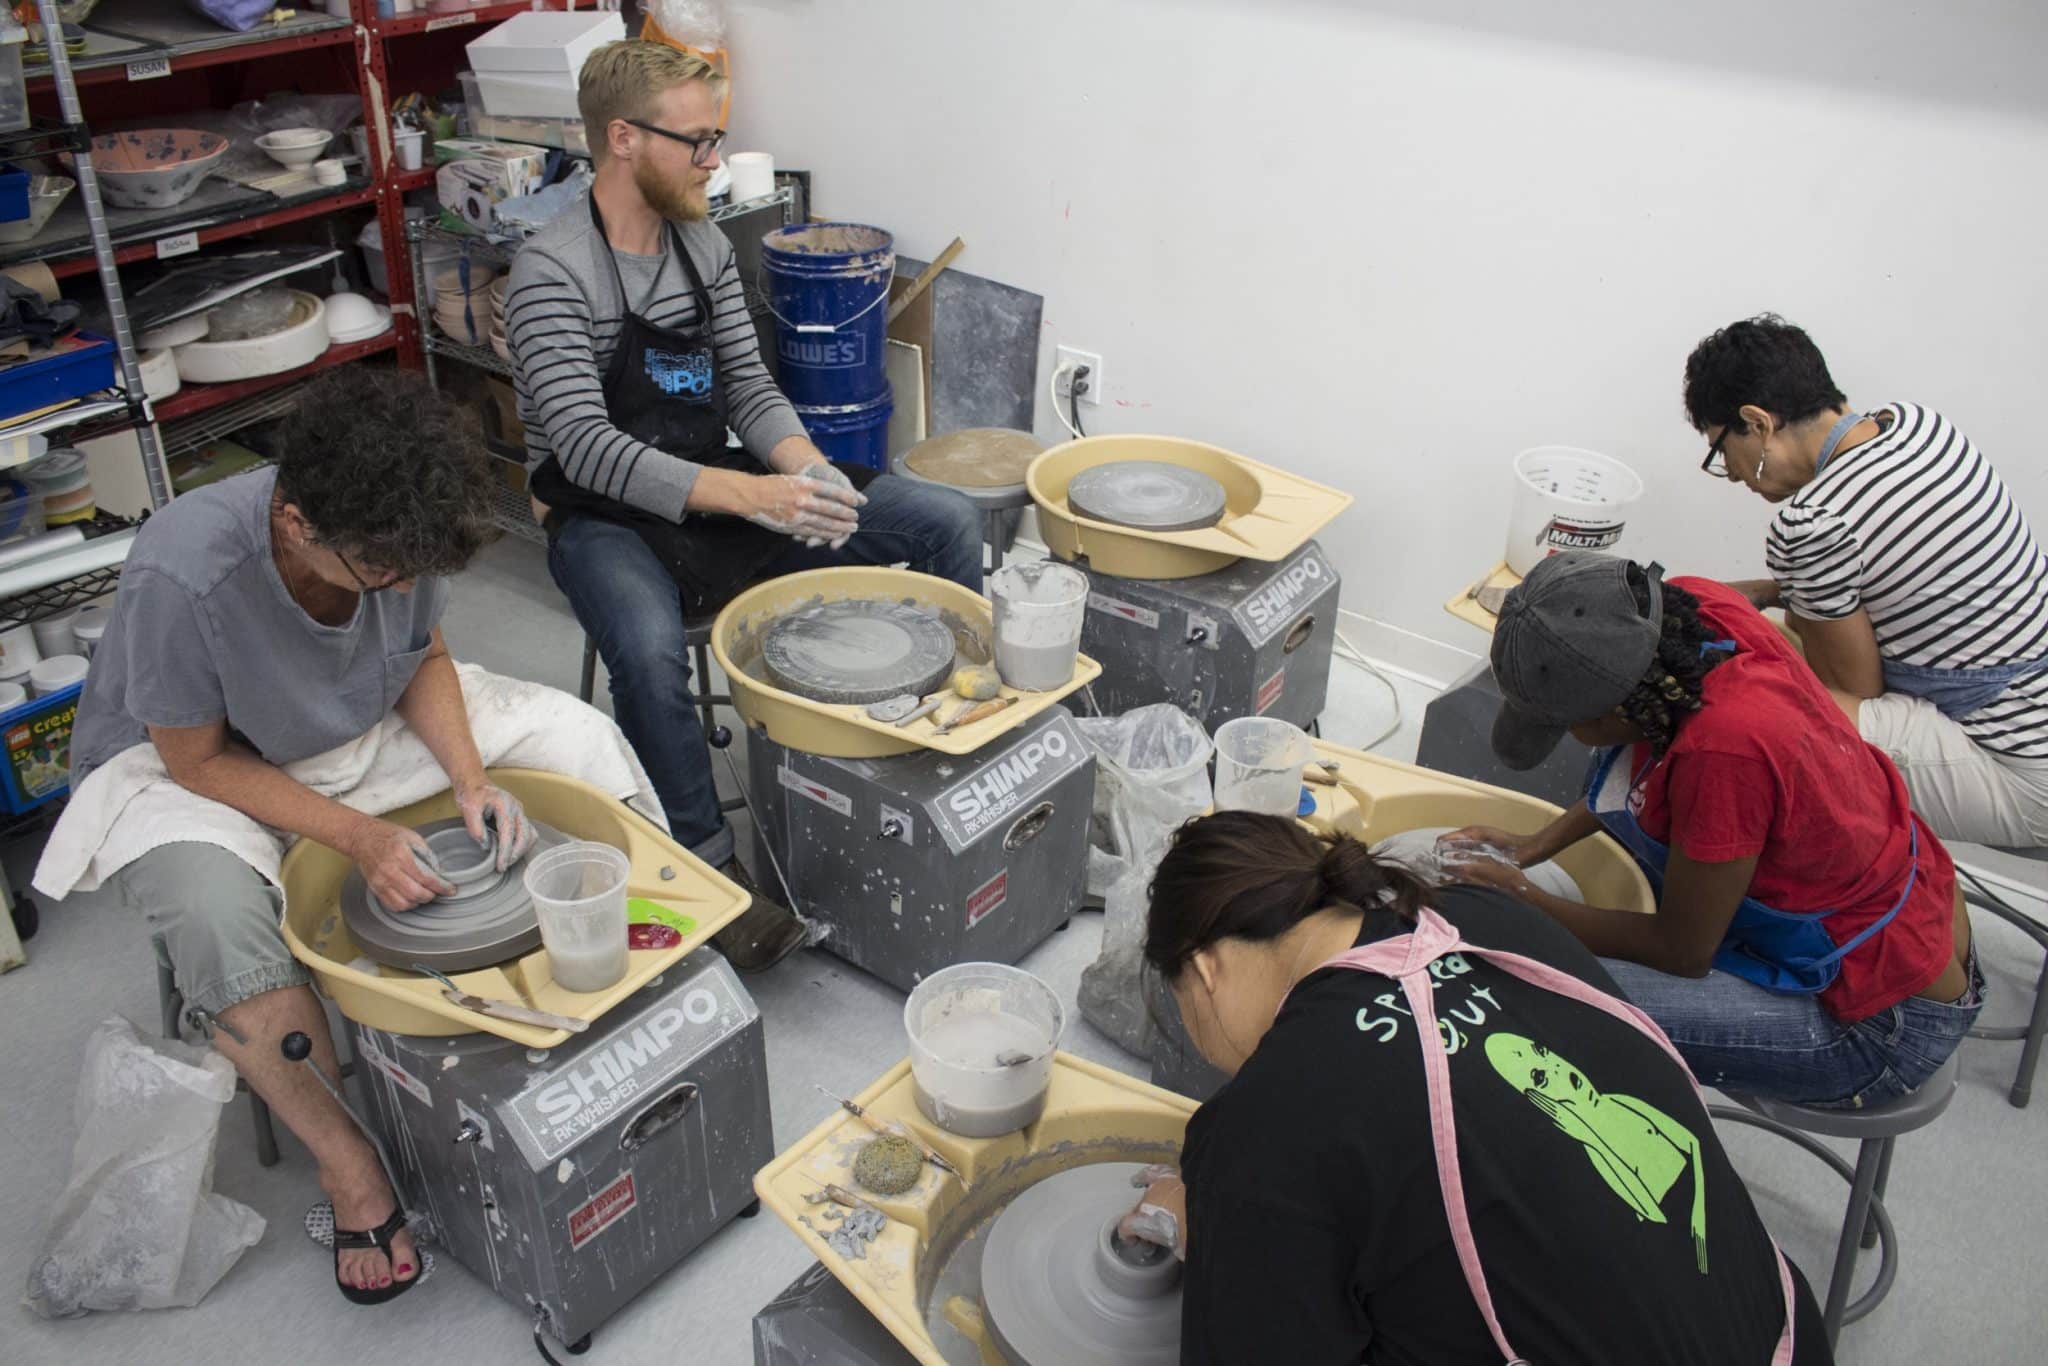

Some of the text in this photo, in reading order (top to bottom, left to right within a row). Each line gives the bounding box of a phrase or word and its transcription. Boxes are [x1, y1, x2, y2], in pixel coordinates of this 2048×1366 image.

[780, 340, 856, 363] LOWE'S
[1247, 557, 1320, 626] SHIMPO
[950, 730, 1067, 821] SHIMPO
[535, 988, 718, 1126] SHIMPO
[553, 1077, 640, 1144] RK-WHISPER
